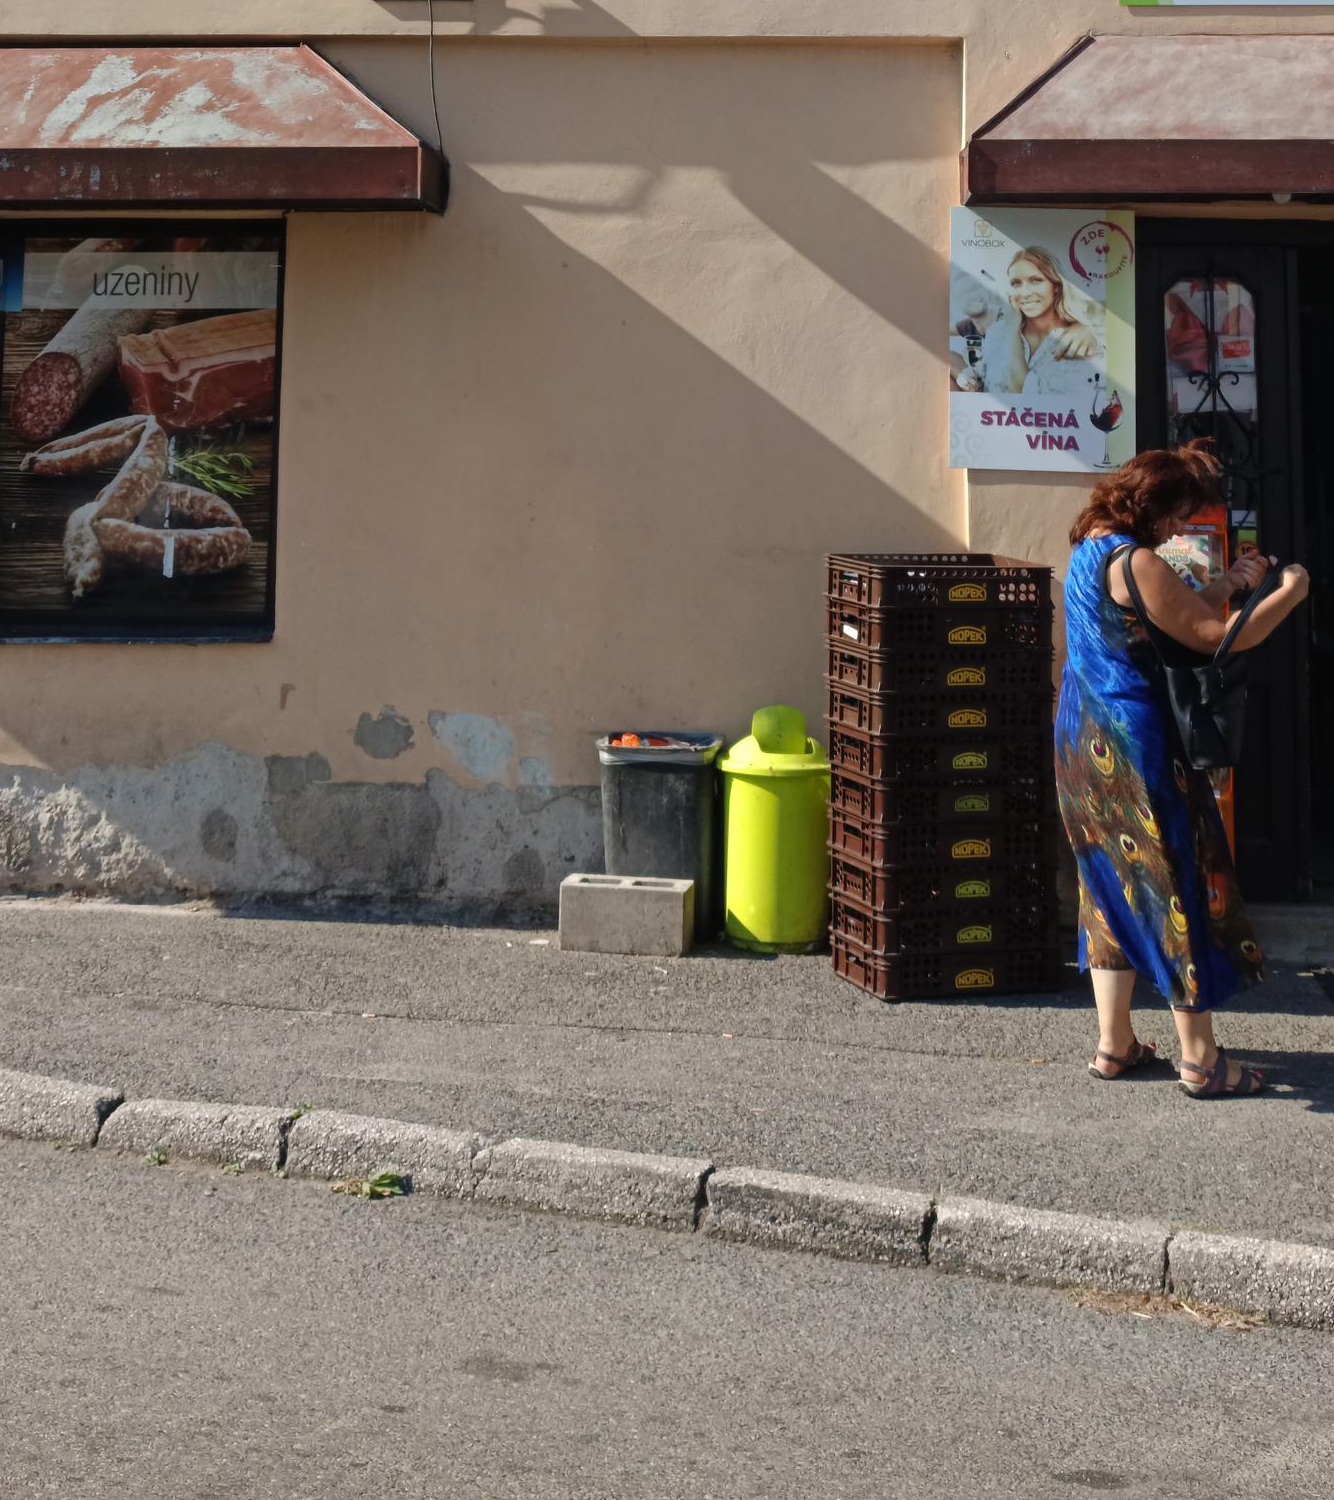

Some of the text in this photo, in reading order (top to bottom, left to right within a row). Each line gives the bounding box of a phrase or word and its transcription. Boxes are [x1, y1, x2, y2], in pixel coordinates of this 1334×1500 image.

[961, 238, 1005, 248] VINOBOX
[1080, 228, 1106, 246] ZDE
[93, 265, 199, 302] uzeniny
[980, 408, 1080, 430] STÁČENÁ
[1026, 431, 1080, 451] VÍNA
[951, 587, 984, 598] NOPEK
[951, 629, 984, 642] NOPEK
[950, 671, 982, 683] NOPEK
[951, 712, 984, 725] NOPEK
[955, 755, 985, 766] NOPEK
[954, 842, 988, 855] NOPEK
[957, 883, 987, 895] NOPEK
[959, 929, 989, 940] NOPEK
[958, 972, 991, 985] NOPEK
